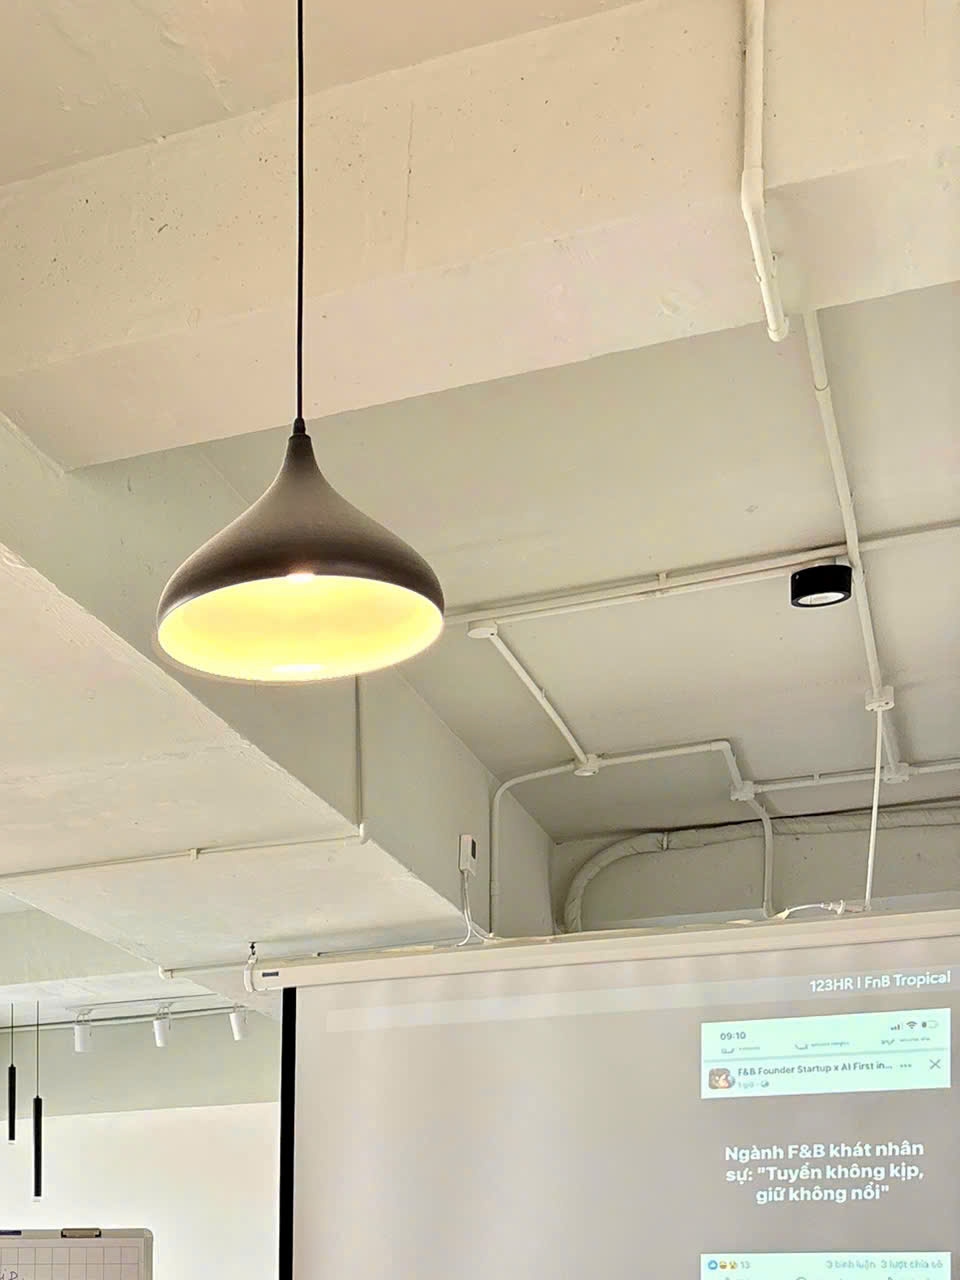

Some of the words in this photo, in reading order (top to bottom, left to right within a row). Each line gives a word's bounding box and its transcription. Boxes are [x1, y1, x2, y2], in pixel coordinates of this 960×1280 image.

[810, 977, 854, 992] 123HR
[864, 975, 890, 989] FnB
[893, 970, 951, 988] Tropical
[720, 1031, 747, 1041] 09:10
[738, 1067, 756, 1076] F&B
[758, 1066, 795, 1076] Founder
[797, 1064, 832, 1074] Startup
[853, 1061, 874, 1070] First
[725, 1144, 784, 1164] Ngành
[788, 1144, 825, 1159] F&B
[829, 1141, 871, 1158] khát
[875, 1140, 924, 1156] nhân
[726, 1167, 753, 1185] sự:
[757, 1162, 822, 1183] "Tuyển
[825, 1163, 885, 1183] không
[889, 1161, 924, 1182] kịp,
[756, 1185, 786, 1204] giữ
[789, 1185, 847, 1203] không
[851, 1181, 889, 1201] nổi"
